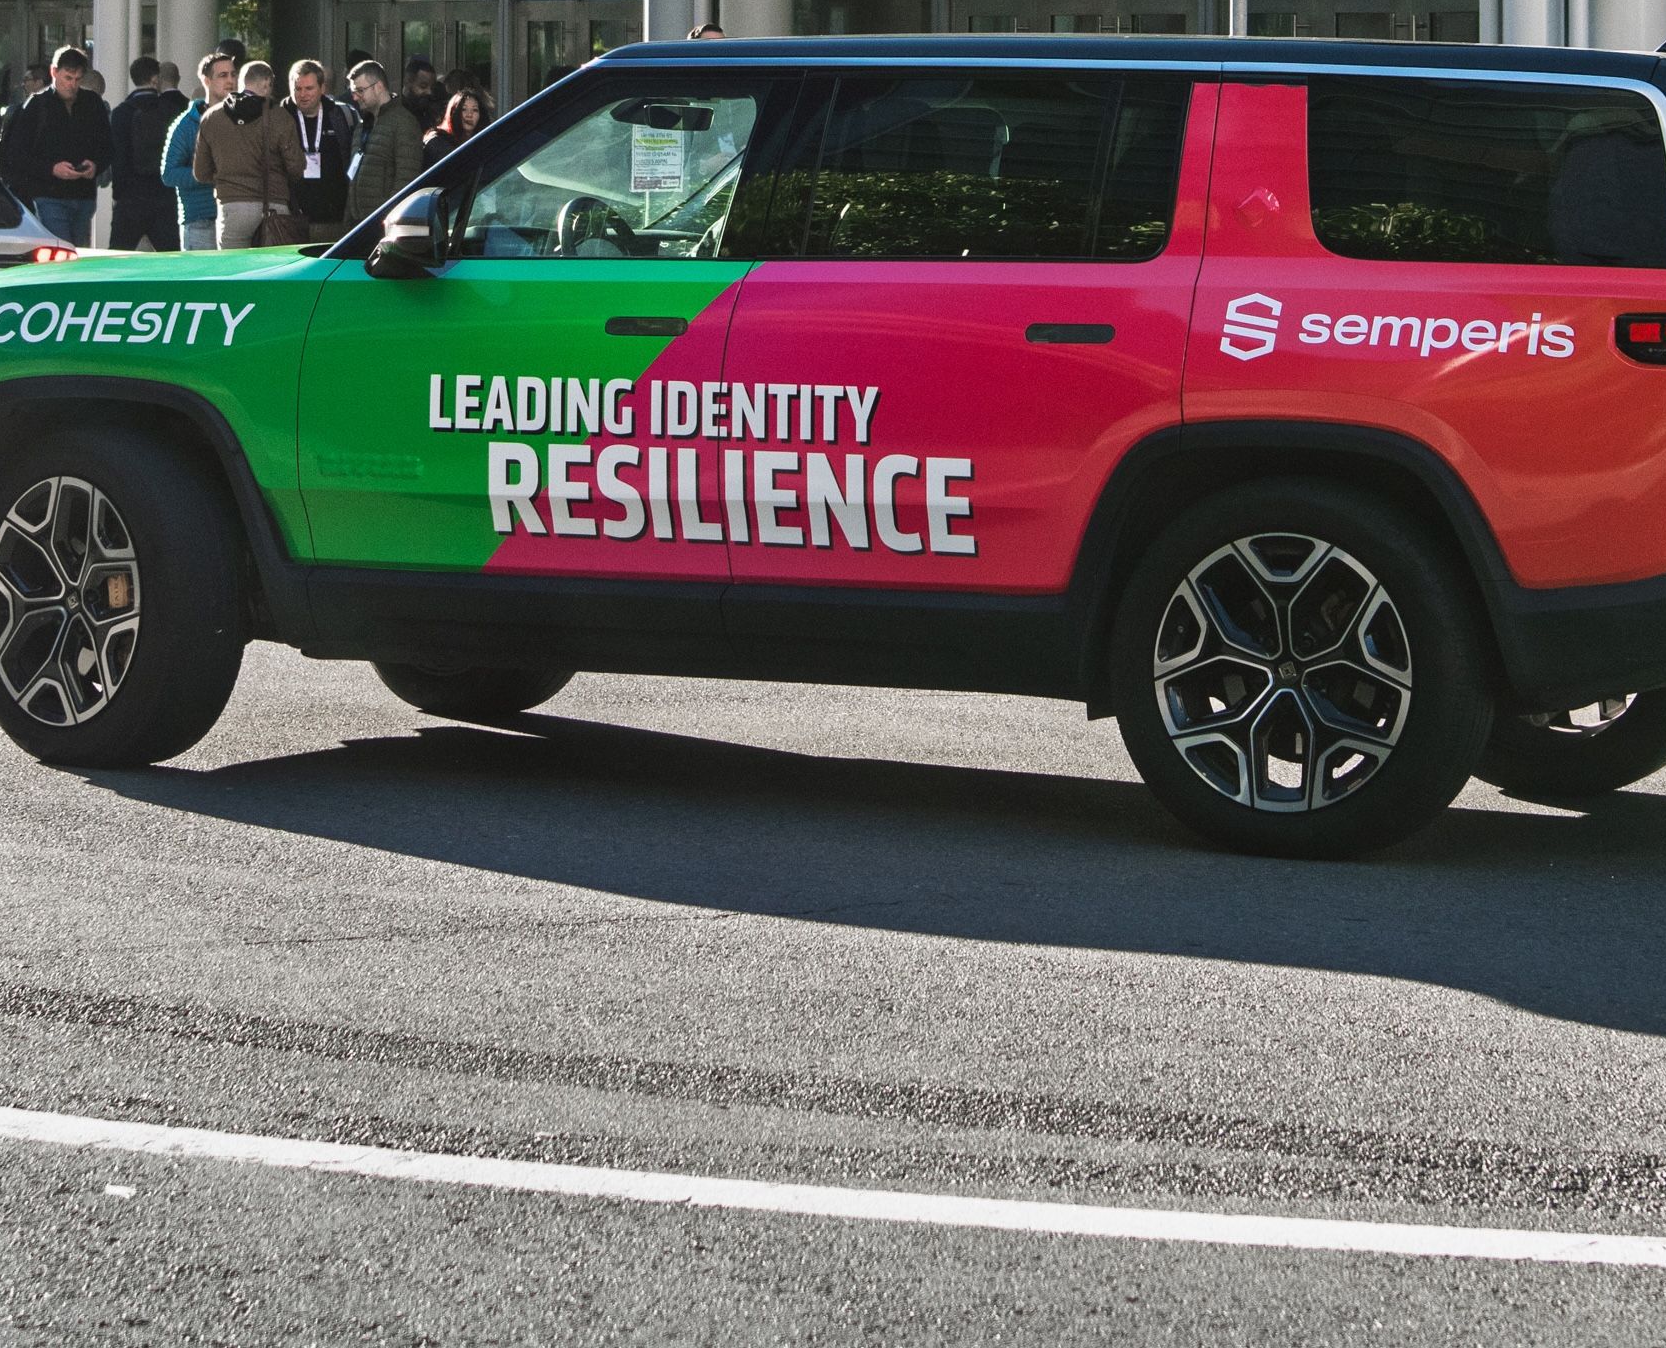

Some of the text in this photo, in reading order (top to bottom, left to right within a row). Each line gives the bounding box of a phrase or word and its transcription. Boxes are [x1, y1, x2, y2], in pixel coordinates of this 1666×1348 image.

[1298, 312, 1575, 358] semperis
[427, 373, 880, 445] LEADING IDENTITY
[487, 441, 979, 557] RESILIENCE
